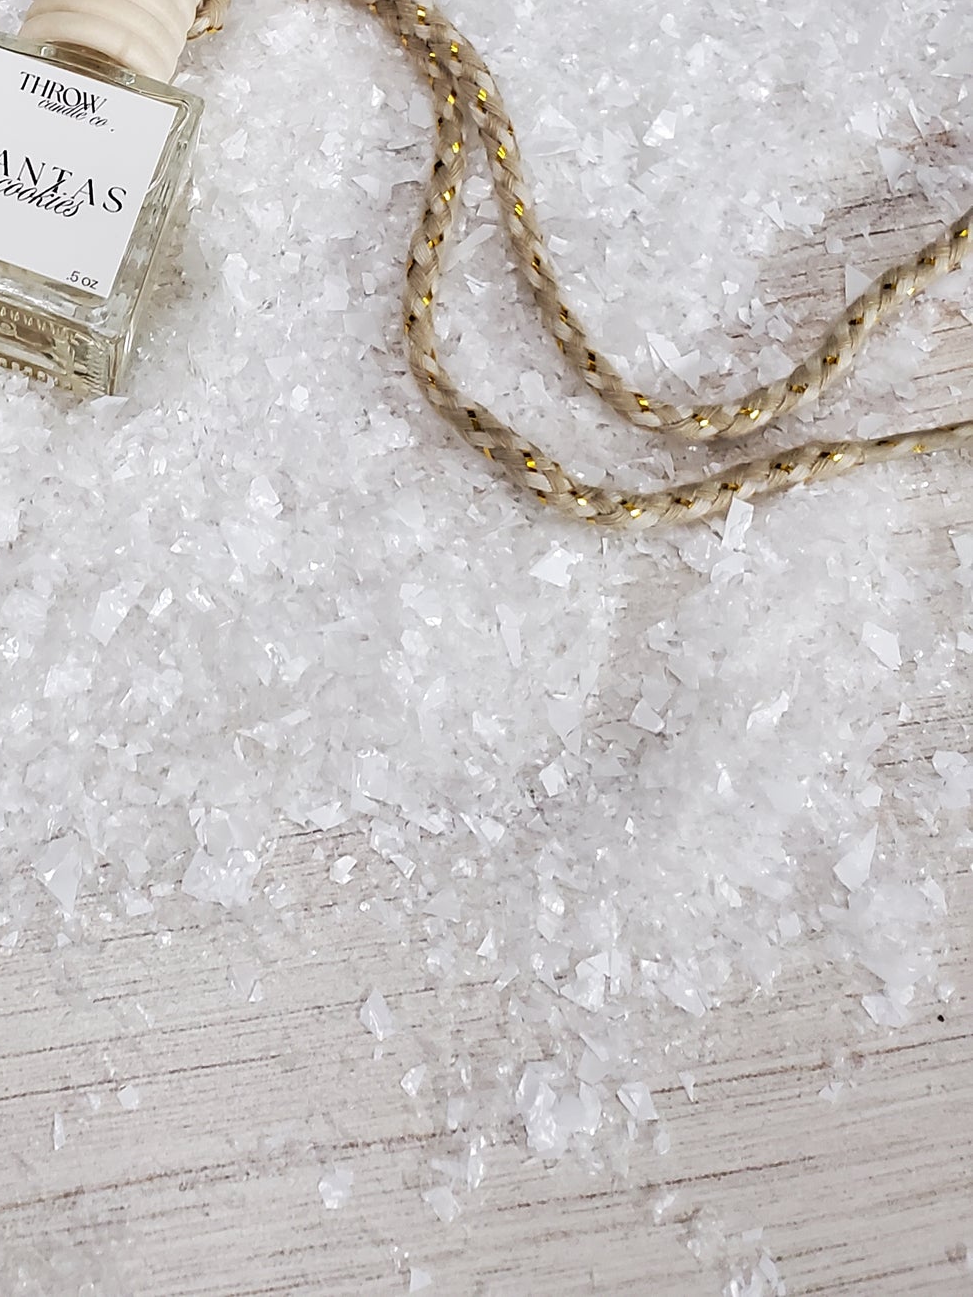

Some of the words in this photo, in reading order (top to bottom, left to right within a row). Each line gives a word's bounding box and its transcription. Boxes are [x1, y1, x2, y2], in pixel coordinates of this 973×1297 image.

[20, 70, 107, 114] THROW
[37, 99, 90, 121] candle
[81, 276, 99, 290] oz
